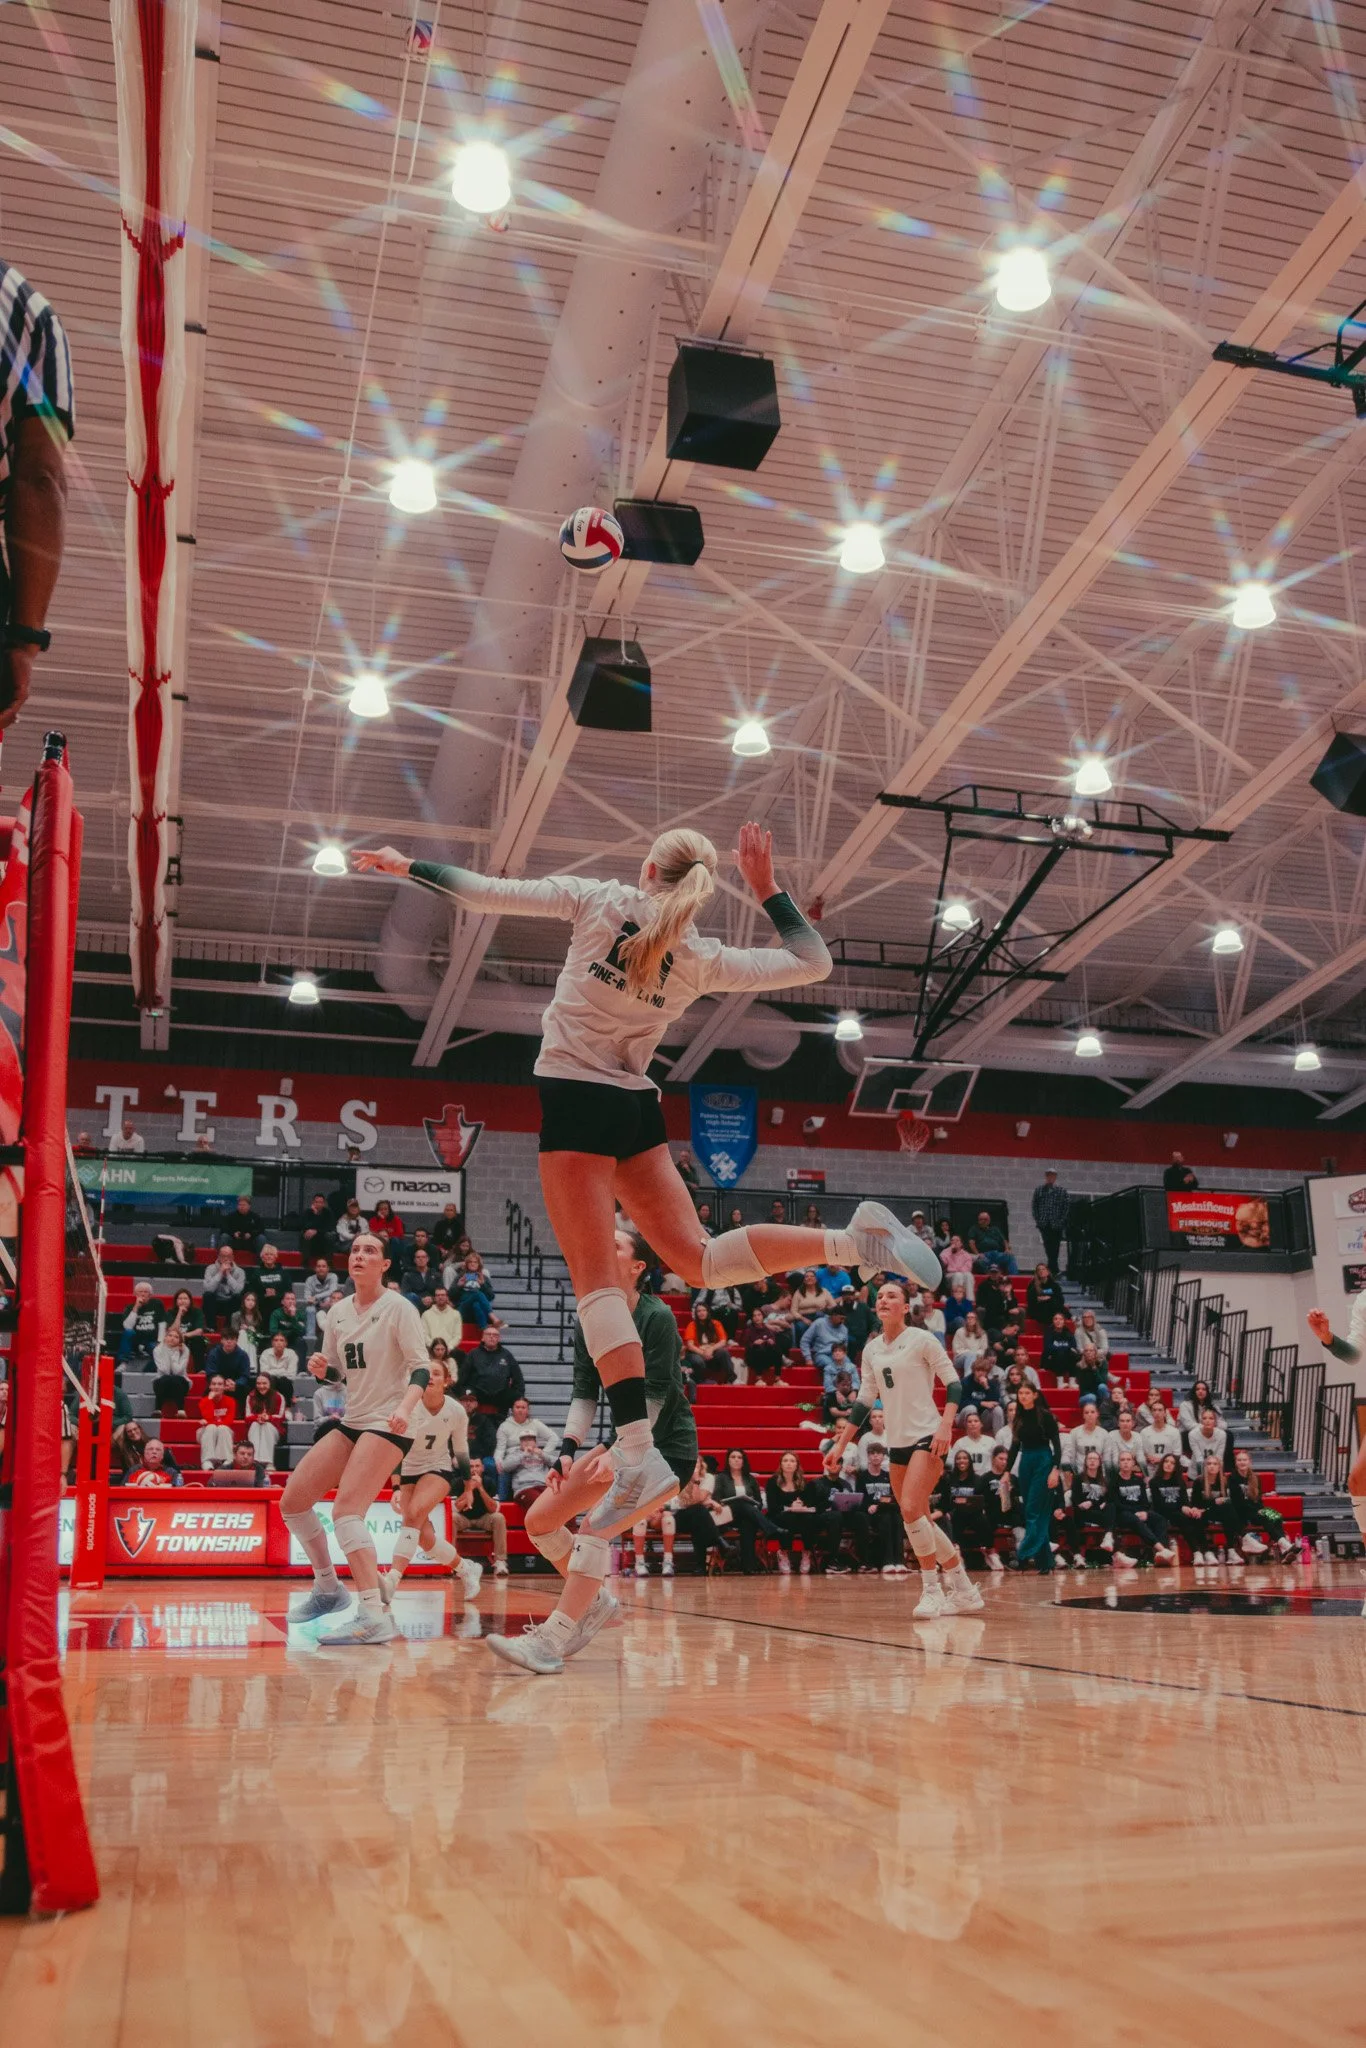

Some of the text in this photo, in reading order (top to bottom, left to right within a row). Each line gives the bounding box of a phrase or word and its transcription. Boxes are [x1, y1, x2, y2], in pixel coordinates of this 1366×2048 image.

[98, 1168, 209, 1184] AHN Sports Medicine
[1178, 1219, 1231, 1231] FIREHOUSE
[344, 1342, 367, 1369] 21
[882, 1366, 894, 1389] 6
[425, 1434, 437, 1450] 7
[170, 1512, 254, 1529] PETERS
[155, 1535, 263, 1553] TOWNSHIP
